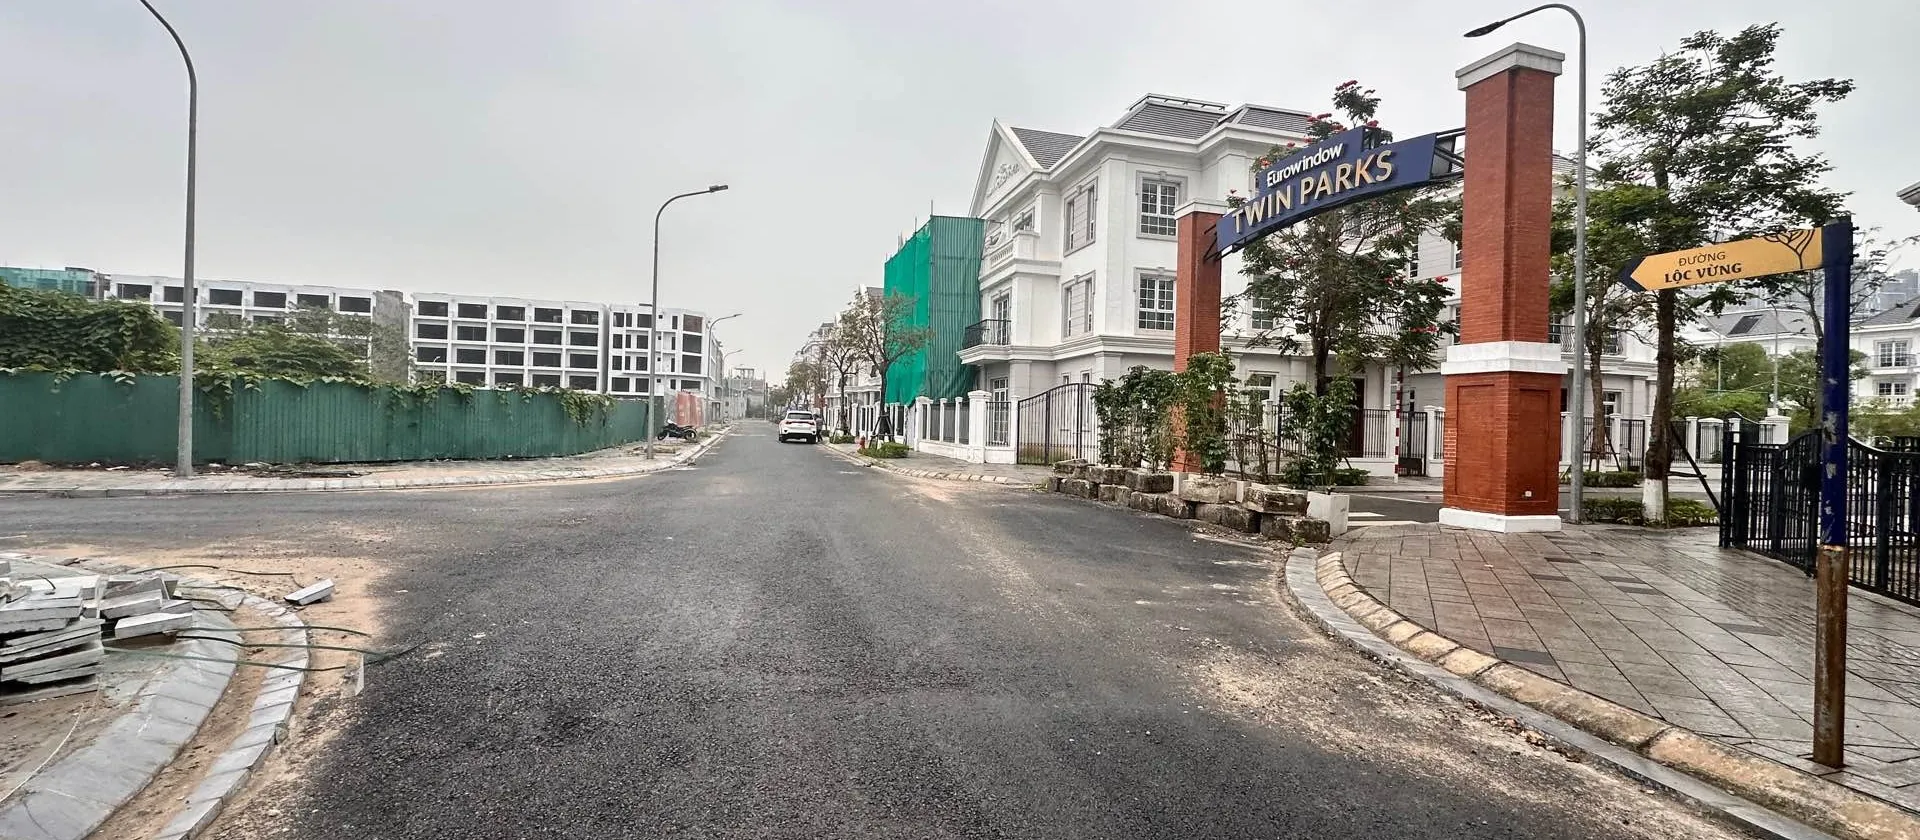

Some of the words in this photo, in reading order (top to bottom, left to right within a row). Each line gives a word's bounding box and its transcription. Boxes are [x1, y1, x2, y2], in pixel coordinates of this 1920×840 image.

[1266, 143, 1344, 187] Eurowindow
[1232, 184, 1292, 234] TWIN
[1300, 150, 1394, 205] PARKS
[1664, 269, 1692, 285] LỘC
[1696, 262, 1742, 278] VỪNG
[1678, 251, 1726, 267] ĐƯỜNG
